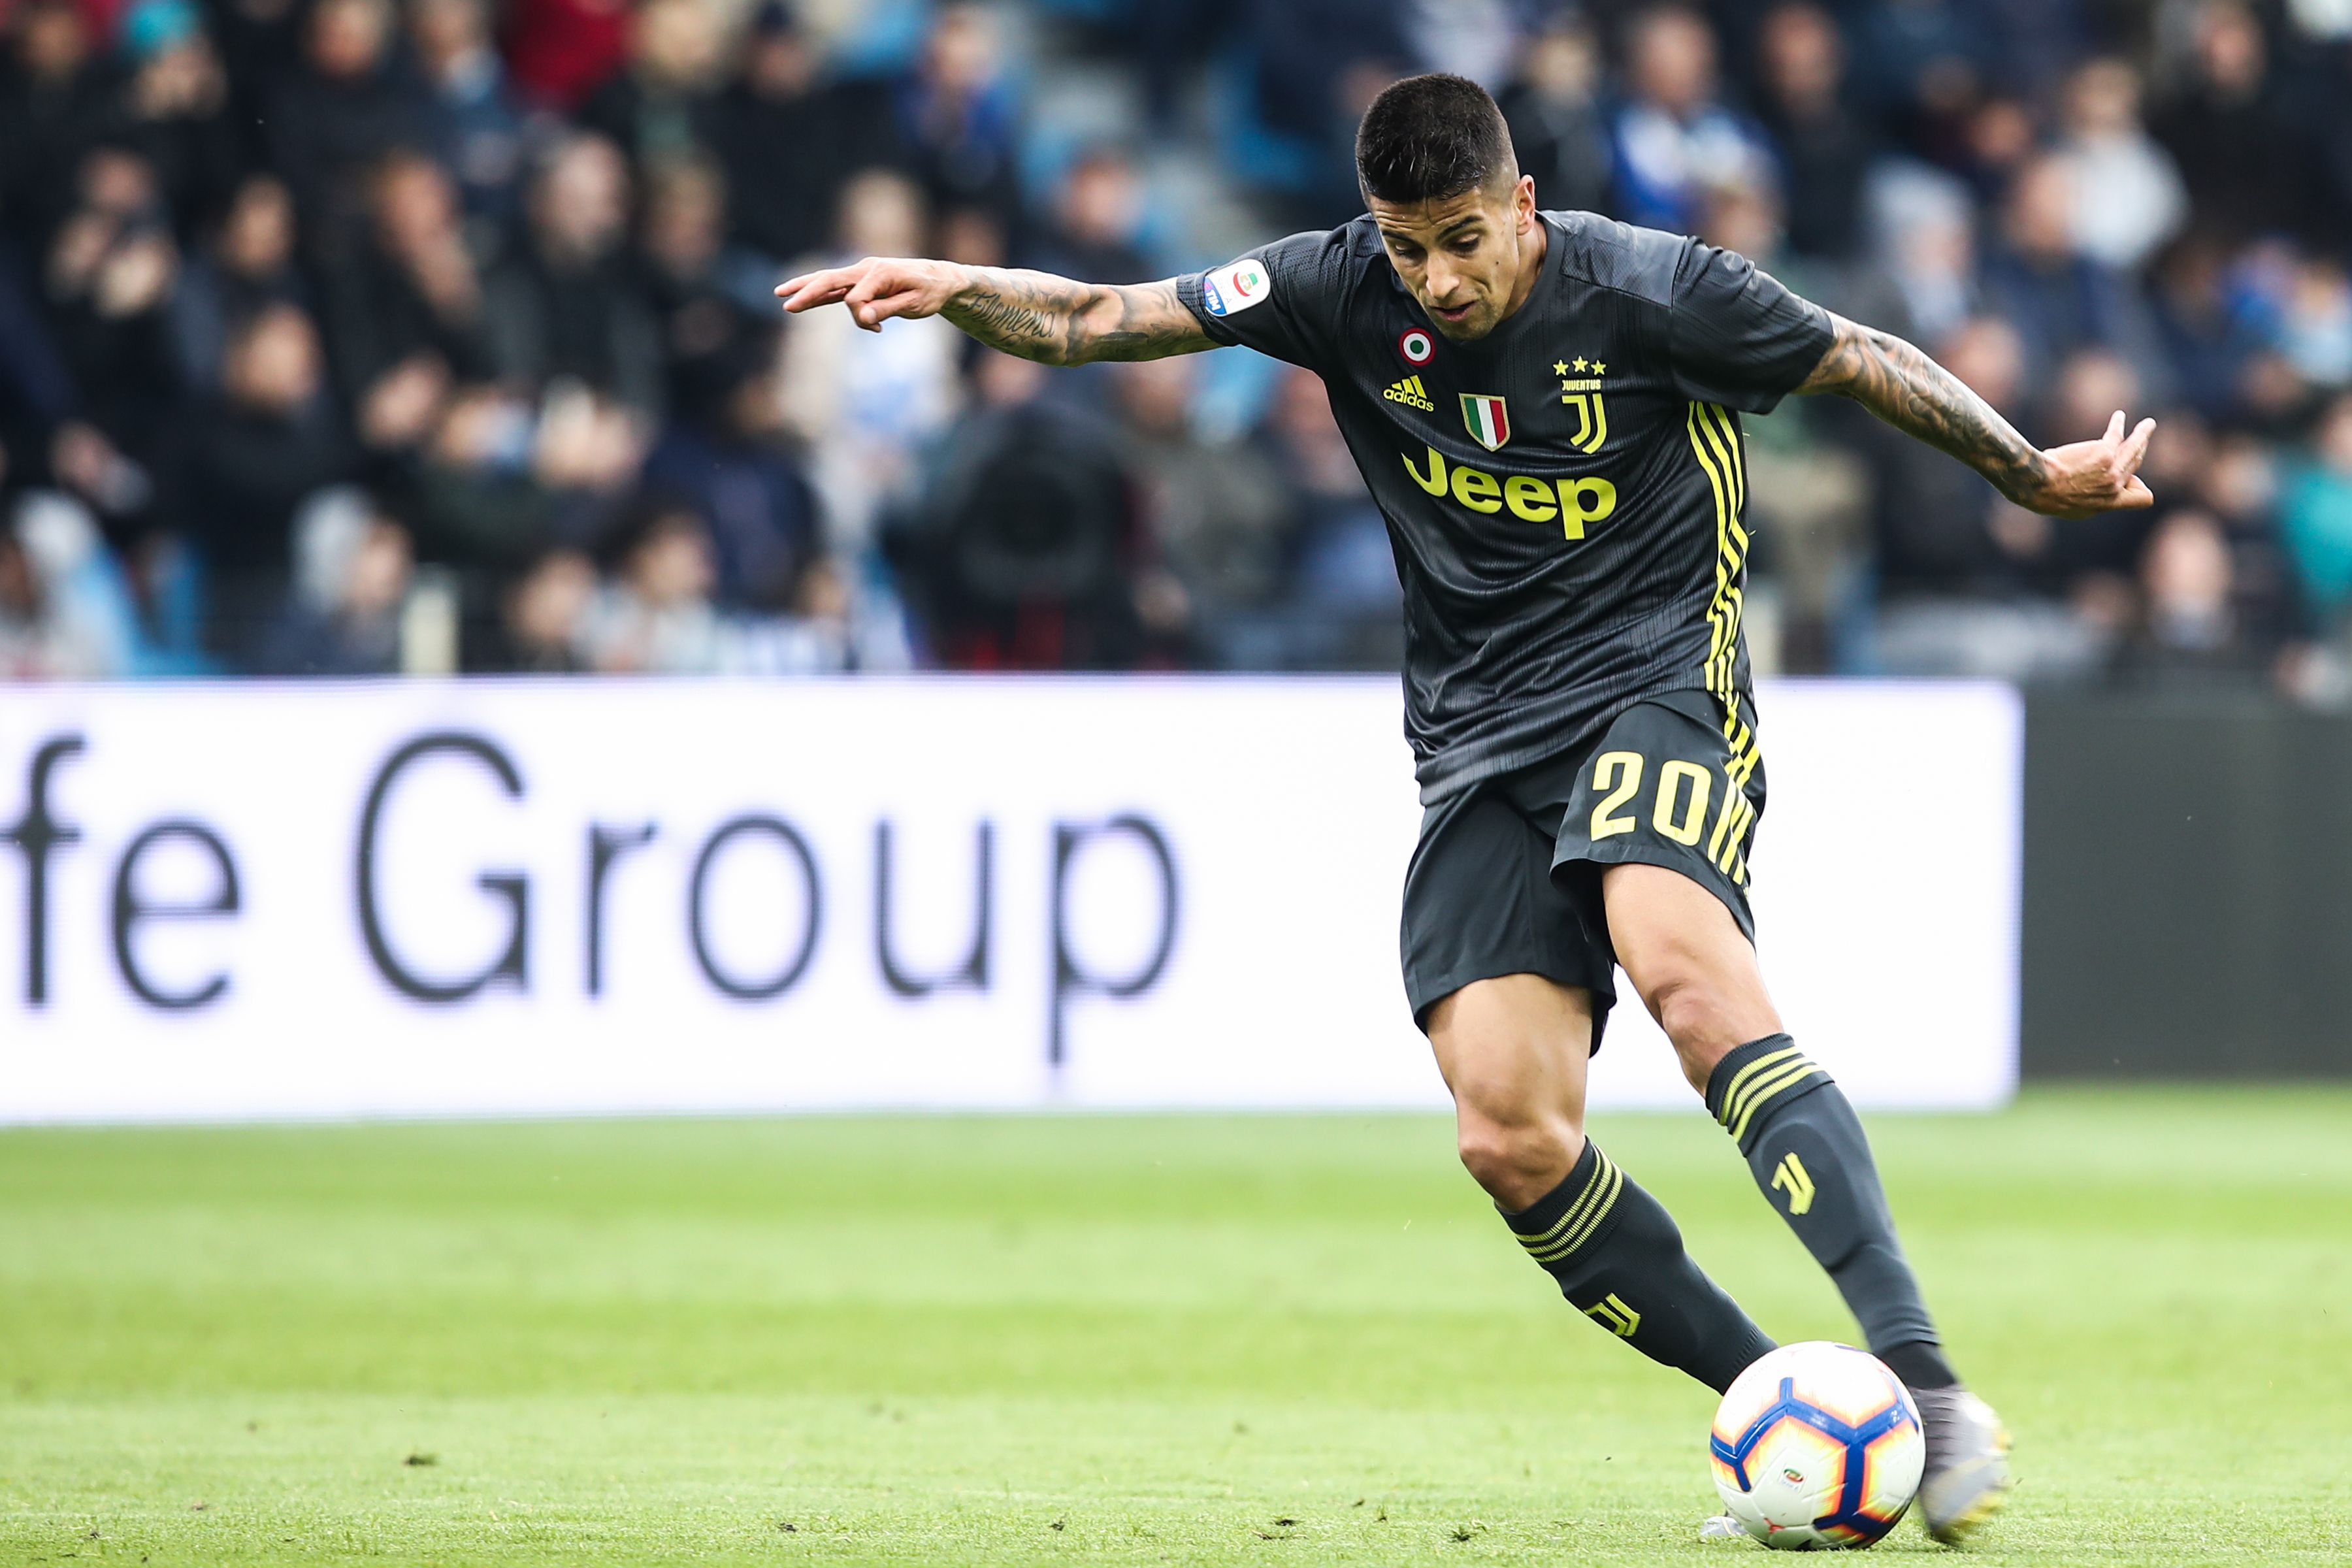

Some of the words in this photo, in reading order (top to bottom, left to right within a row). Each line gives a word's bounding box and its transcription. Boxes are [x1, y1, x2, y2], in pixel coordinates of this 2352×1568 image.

[1205, 289, 1222, 311] TIM
[1383, 388, 1434, 412] adidas
[1561, 379, 1601, 391] JUVENTUS
[1401, 446, 1617, 540] Jeep
[1590, 751, 1712, 847] 20
[0, 732, 242, 1013] fe
[353, 728, 1179, 1067] Group
